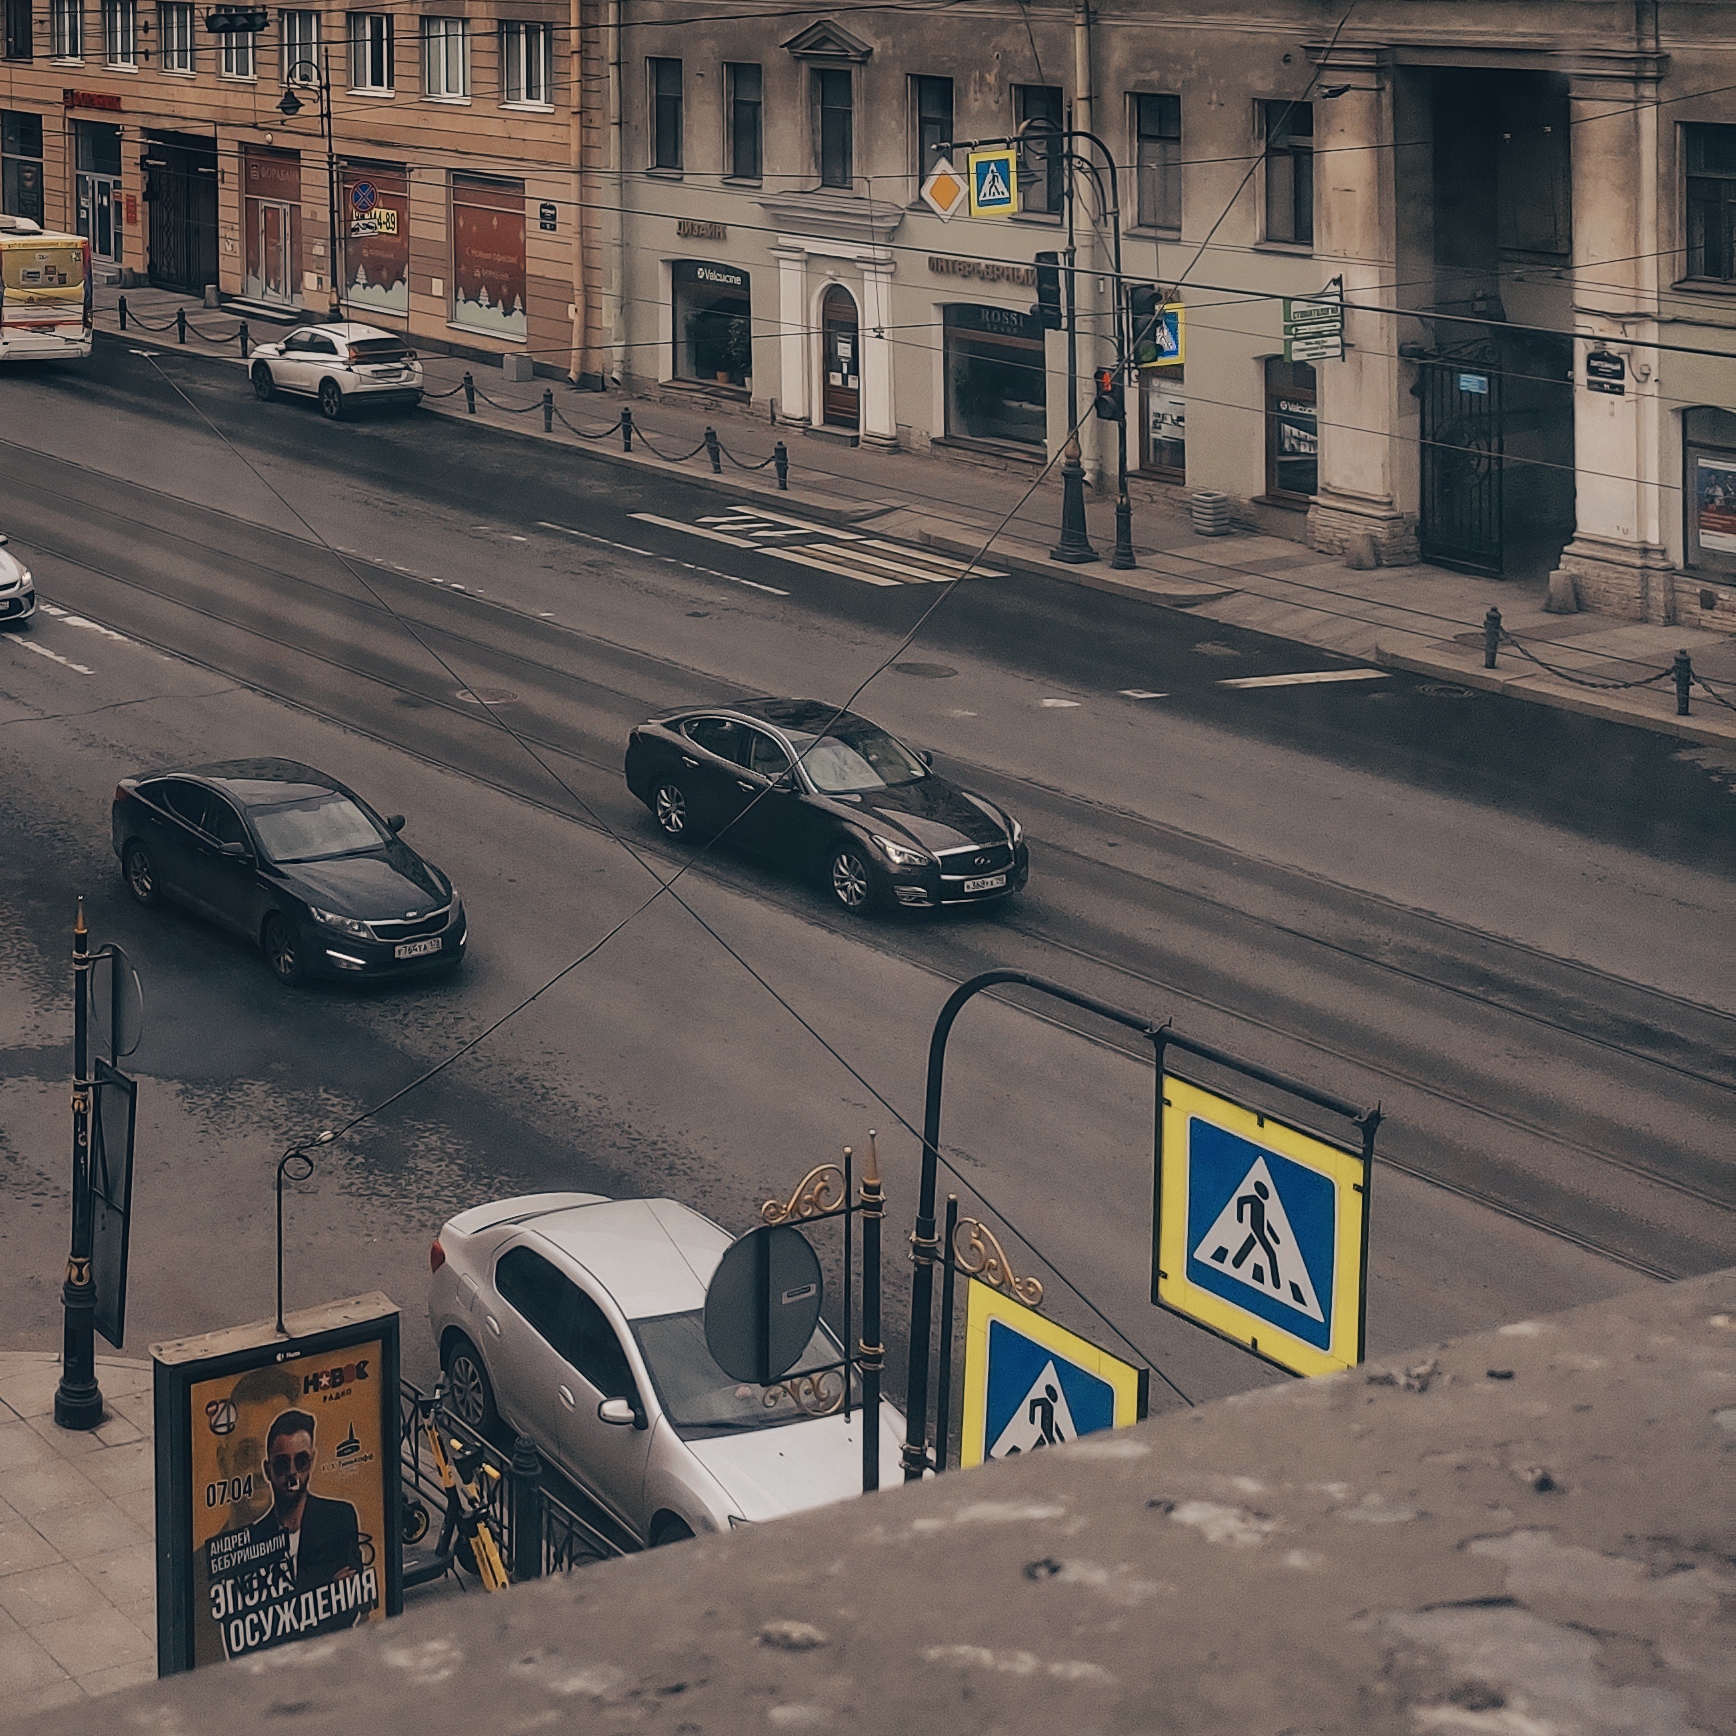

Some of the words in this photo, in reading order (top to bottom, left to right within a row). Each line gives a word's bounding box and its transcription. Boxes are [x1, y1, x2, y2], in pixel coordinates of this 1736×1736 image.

[704, 268, 742, 285] Valcucine
[322, 1388, 352, 1403] РАДИО
[206, 1474, 253, 1508] 07.04
[210, 1528, 251, 1557] АНДРЕЙ
[211, 1533, 286, 1575] БЕБУРИШВИЛИ
[210, 1559, 295, 1620] ЭПОХА
[229, 1567, 378, 1654] ОСУЖДЕНИЯ
